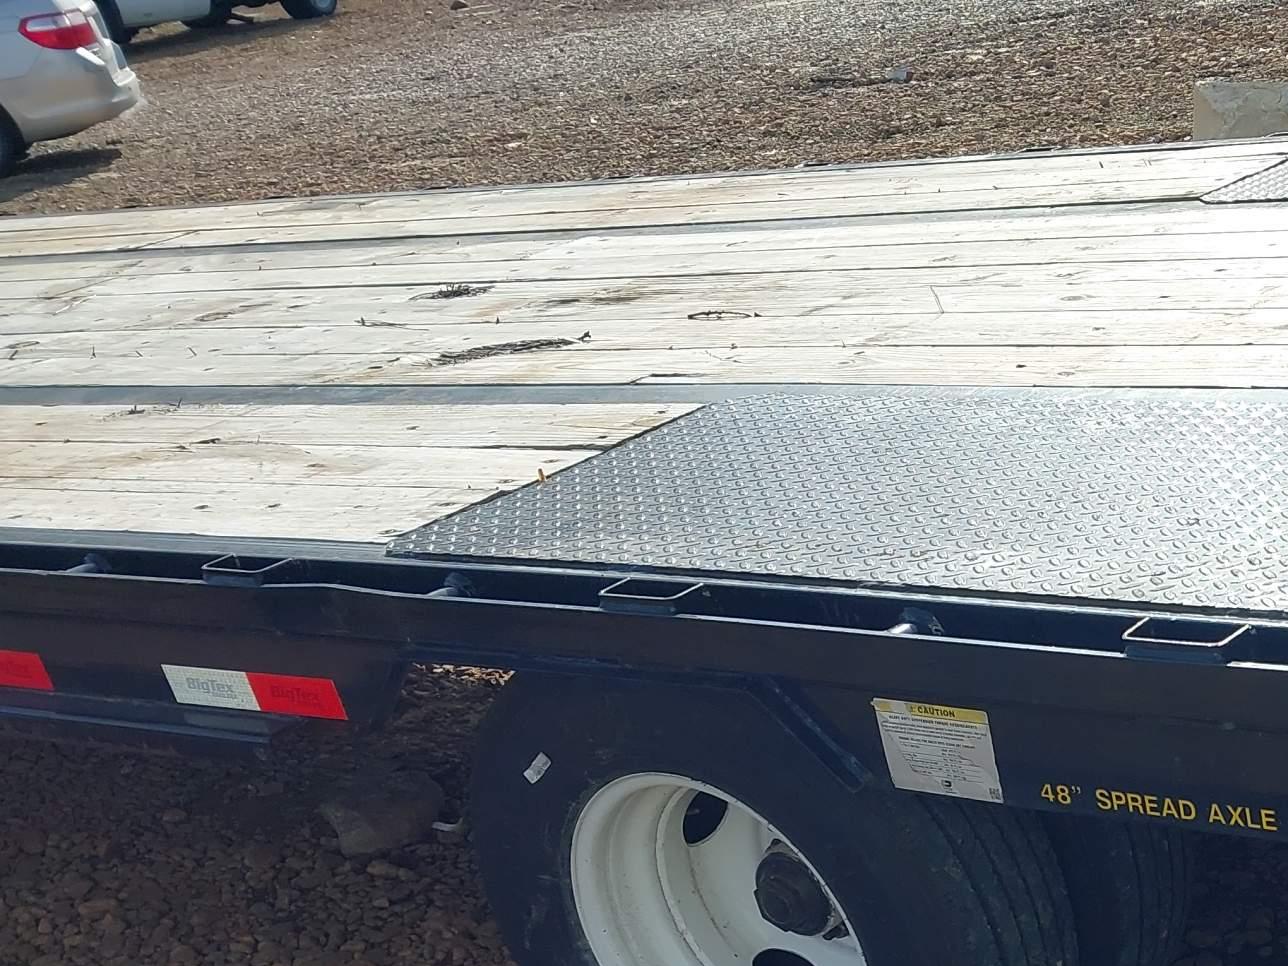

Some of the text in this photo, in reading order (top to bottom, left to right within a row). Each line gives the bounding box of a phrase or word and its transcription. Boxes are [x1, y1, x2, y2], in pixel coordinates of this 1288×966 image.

[186, 677, 234, 694] BigTex
[917, 706, 956, 718] CAUTION
[1095, 789, 1197, 821] SPREAD
[1208, 803, 1279, 832] AXLE
